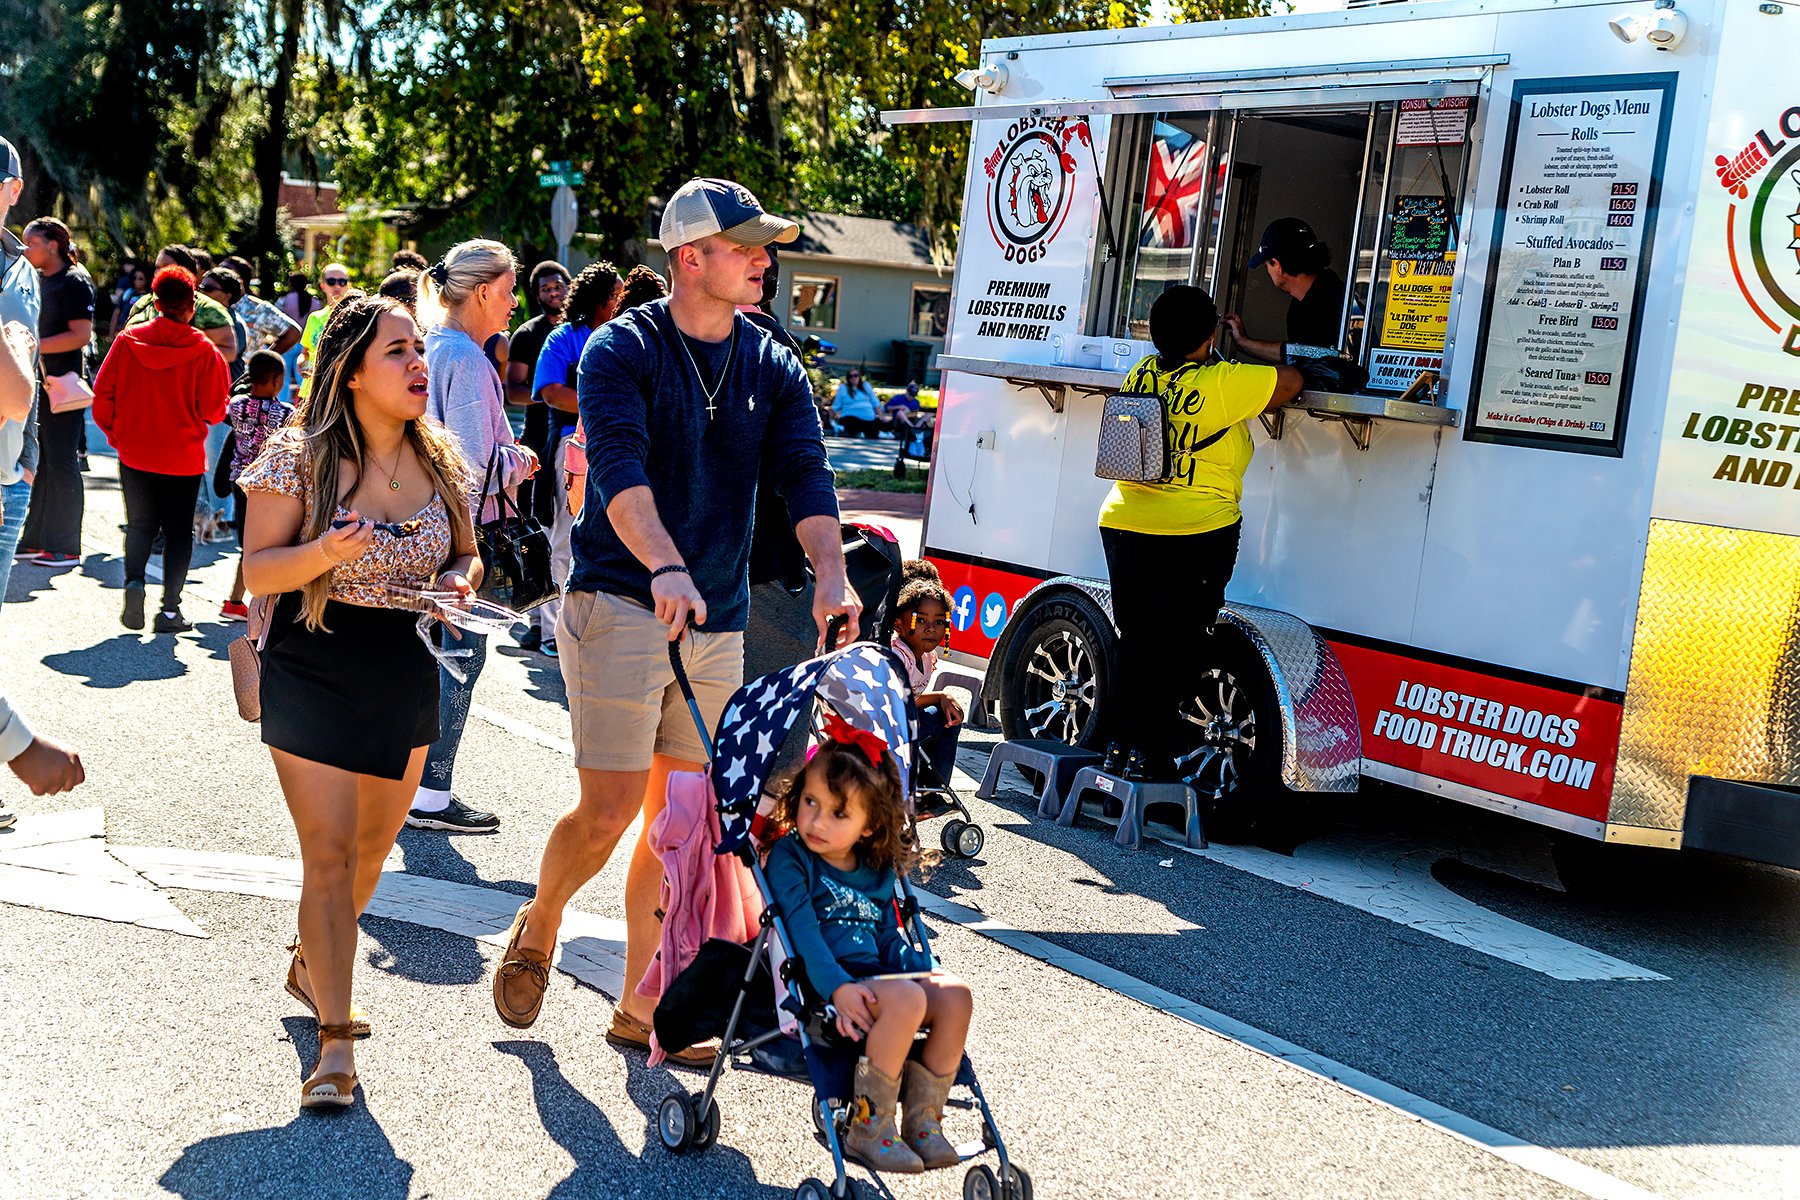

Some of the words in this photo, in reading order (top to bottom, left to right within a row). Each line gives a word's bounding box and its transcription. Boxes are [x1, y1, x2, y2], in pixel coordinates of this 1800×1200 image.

[1401, 100, 1427, 110] CONSUM
[1530, 102, 1578, 118] Lobster
[1580, 100, 1611, 120] Dogs
[1613, 98, 1650, 115] Menu
[1571, 127, 1599, 140] Rolls
[1525, 185, 1553, 194] Lobster
[1554, 185, 1570, 194] Roll
[1612, 185, 1636, 194] 21.50
[1524, 200, 1542, 209] Crab
[1543, 200, 1558, 209] Roll
[1611, 200, 1635, 210] 16.00
[1521, 215, 1548, 226] Shrimp
[1549, 216, 1565, 224] Roll
[1610, 216, 1632, 225] 14.00
[1526, 235, 1564, 249] Stuffed
[1565, 237, 1614, 250] Avocados
[1004, 239, 1046, 264] DOGS
[1414, 260, 1433, 275] NEW
[1432, 261, 1455, 276] DOGS
[1553, 257, 1572, 268] Plan
[1574, 258, 1581, 268] B
[1602, 259, 1625, 269] 11.50
[987, 280, 1051, 299] PREMIUM
[968, 300, 1025, 318] LOBSTER
[1024, 303, 1067, 321] ROLLS
[1589, 302, 1612, 312] Shrimp
[1539, 314, 1558, 326] Free
[1560, 316, 1578, 326] Bird
[1594, 318, 1616, 328] 13.00
[977, 321, 1007, 338] AND
[1005, 323, 1050, 341] MORE!
[1375, 354, 1400, 365] MAKE
[1400, 356, 1408, 366] IT
[1408, 357, 1415, 366] A
[1415, 357, 1431, 367] BIG
[1430, 358, 1443, 369] DO
[1377, 367, 1394, 376] FOR
[1393, 368, 1415, 379] ONLY
[1525, 367, 1553, 379] Seared
[1555, 369, 1576, 381] Tuna
[1588, 374, 1610, 384] 15.00
[1486, 412, 1503, 420] Make
[1515, 415, 1535, 424] Combo
[1536, 417, 1556, 427] (Chips
[1564, 420, 1585, 430] Drink)
[1590, 422, 1604, 431] 3.00
[1682, 412, 1800, 453] LOBST
[1712, 455, 1793, 488] AND
[1394, 680, 1504, 730] LOBSTER
[1502, 705, 1580, 748] DOGS
[1372, 709, 1438, 750] FOOD
[1439, 726, 1597, 790] TRUCK.COM
